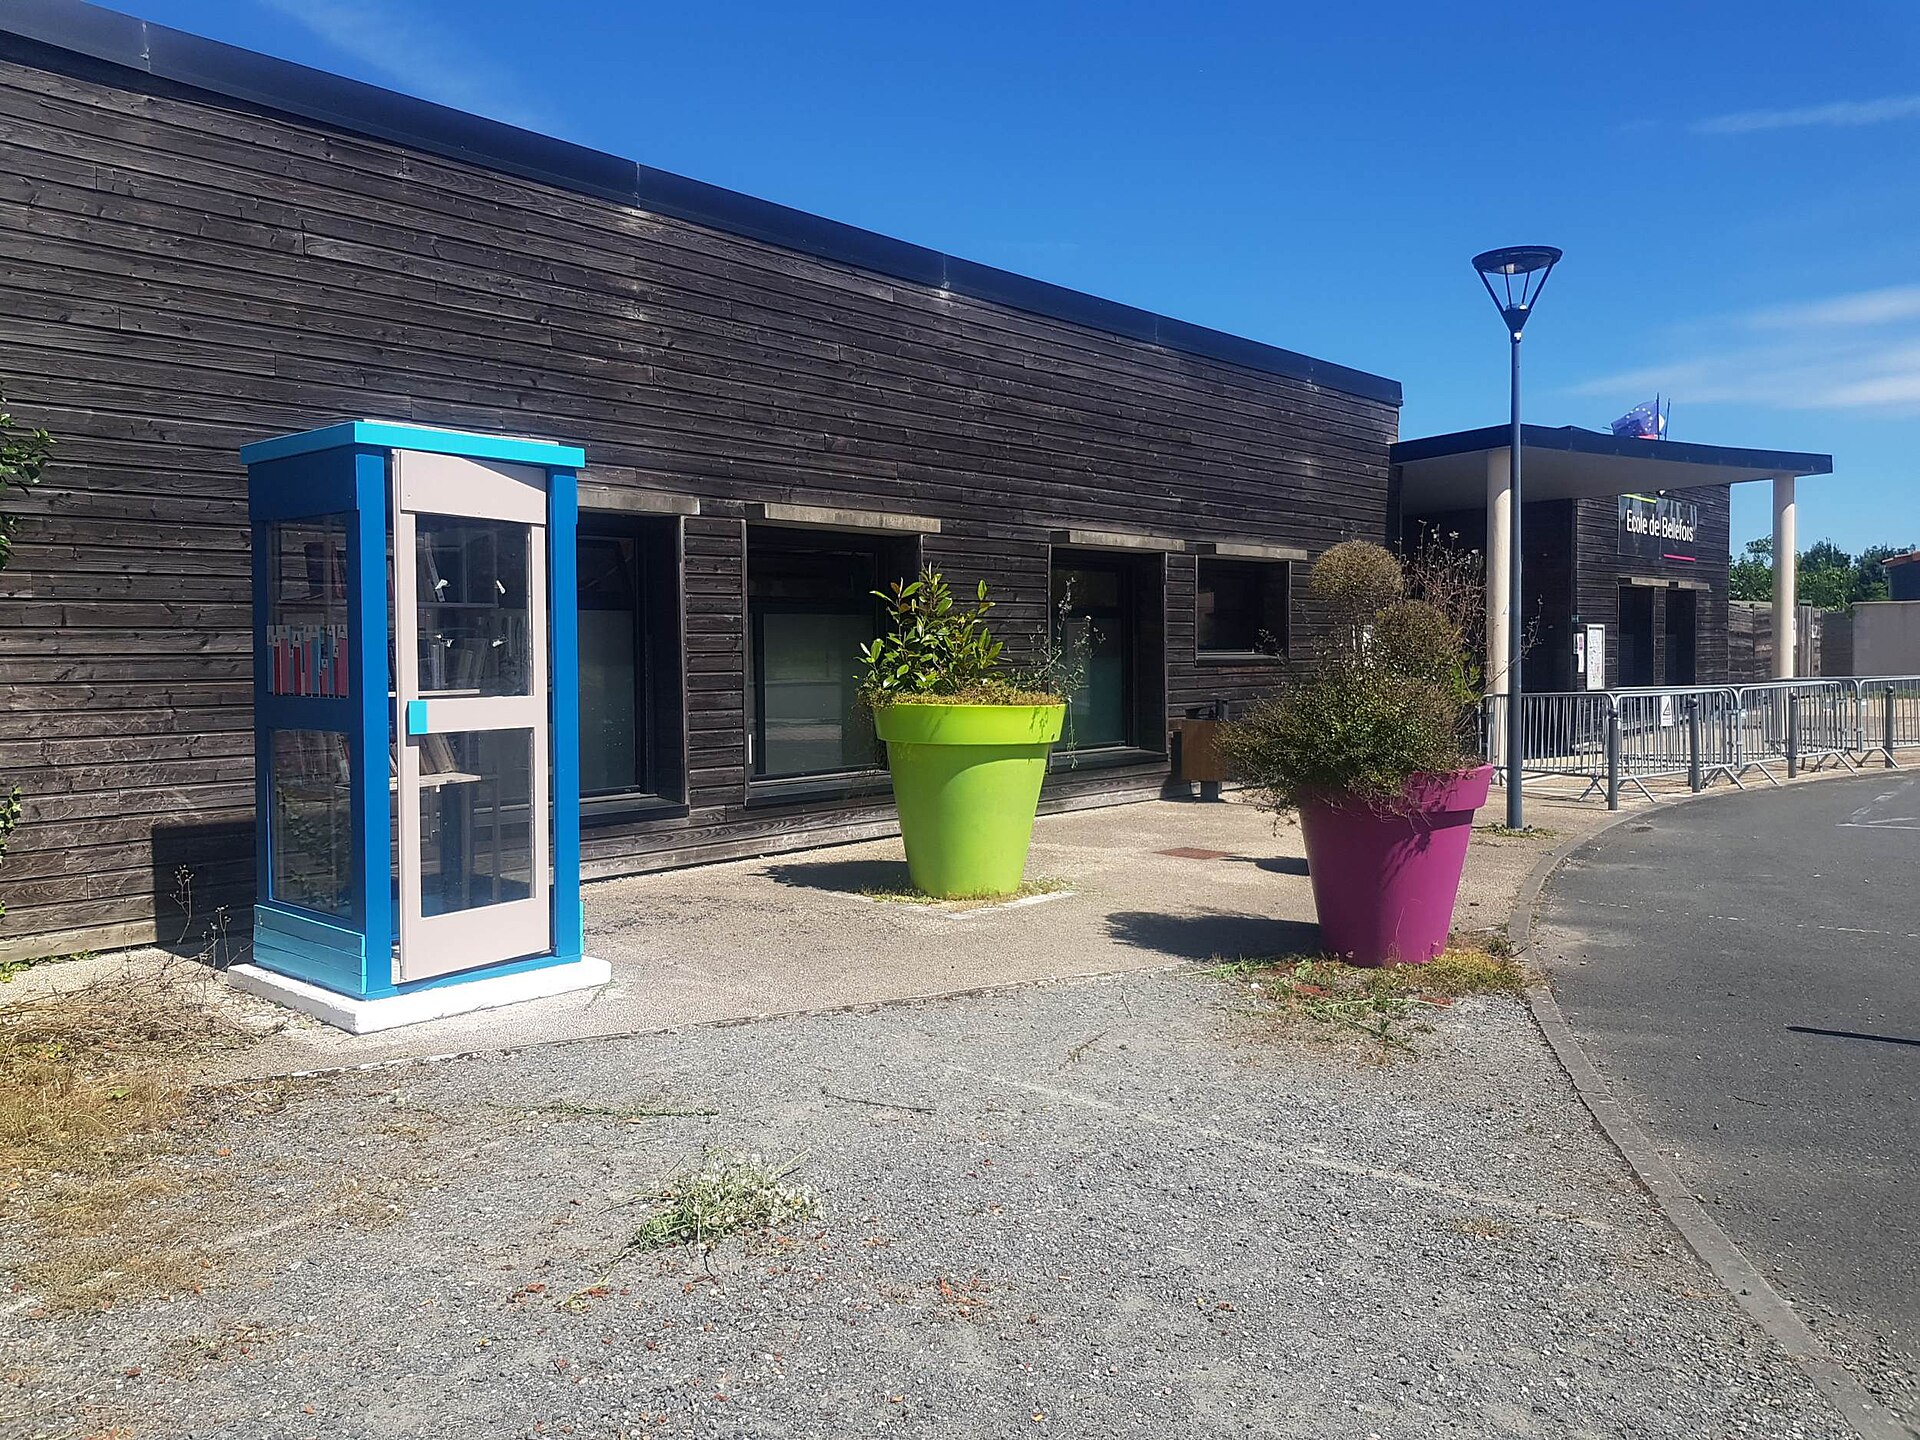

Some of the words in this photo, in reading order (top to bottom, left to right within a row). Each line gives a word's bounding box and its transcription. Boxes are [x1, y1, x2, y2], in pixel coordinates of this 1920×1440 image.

[1626, 509, 1648, 534] Ecole
[1649, 513, 1660, 536] de
[1662, 516, 1694, 542] Bellefois
